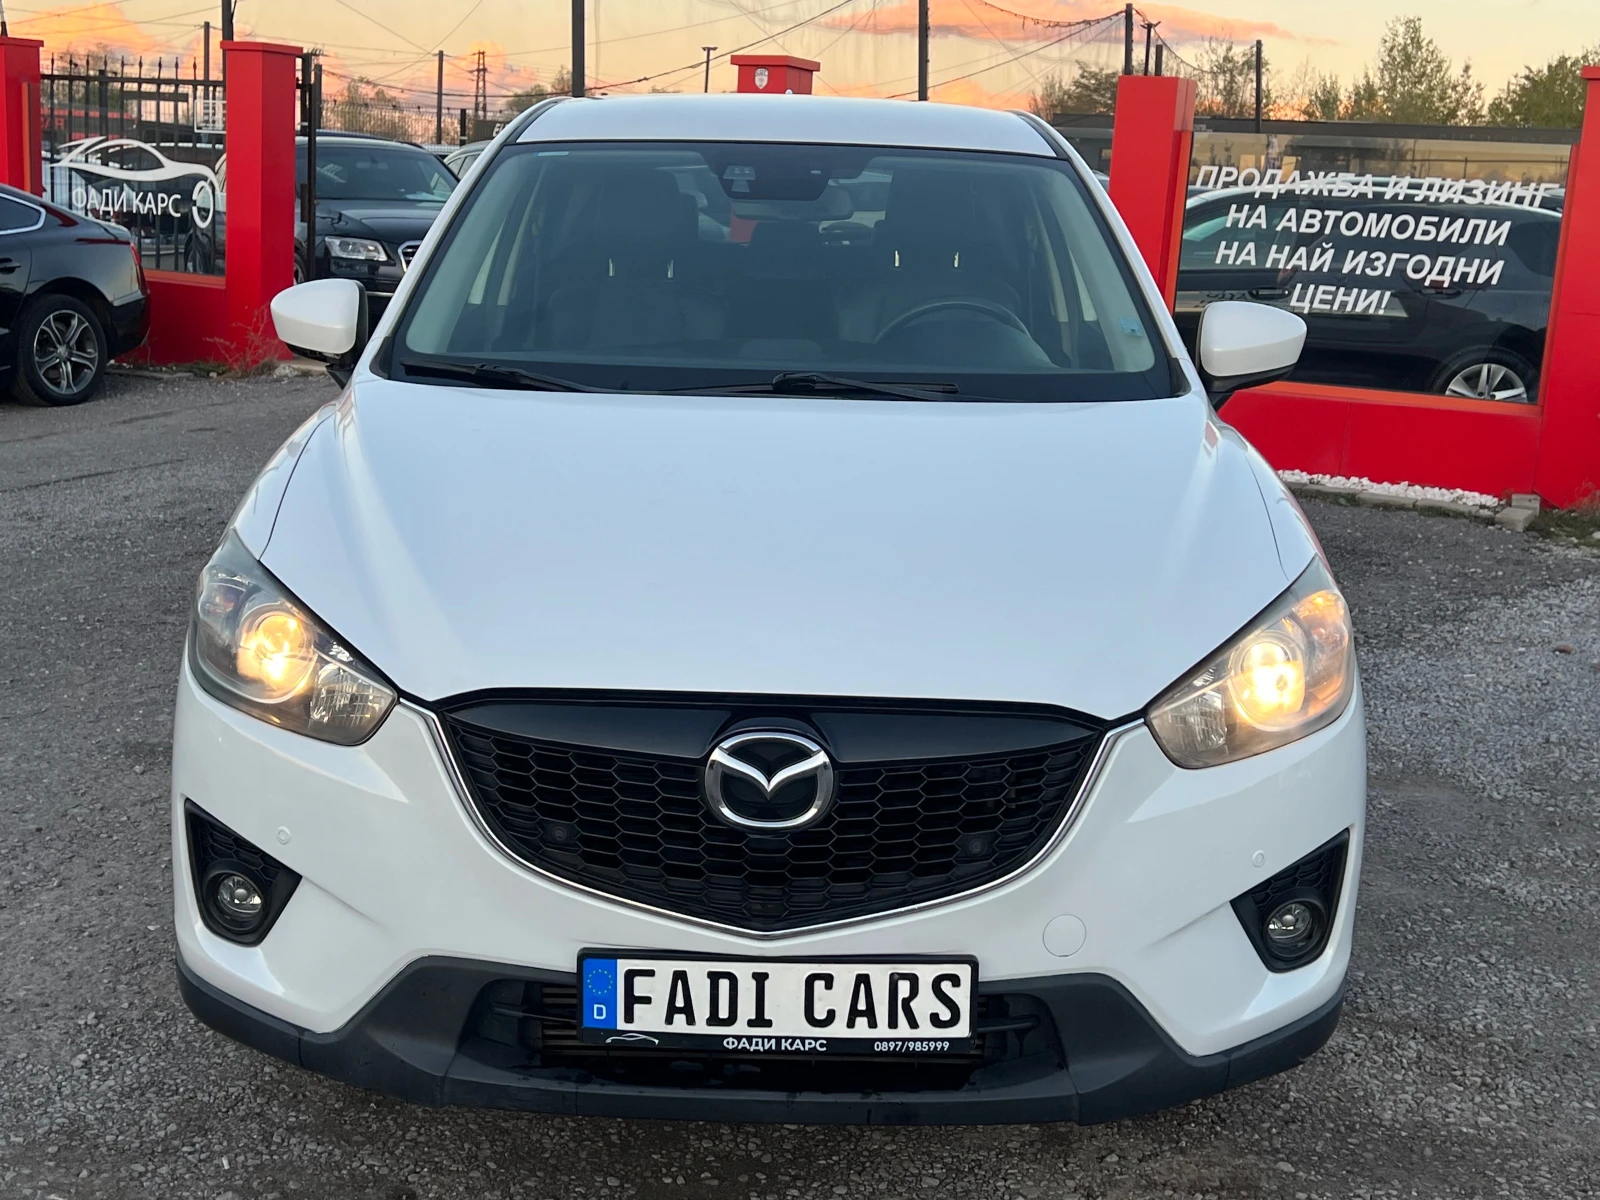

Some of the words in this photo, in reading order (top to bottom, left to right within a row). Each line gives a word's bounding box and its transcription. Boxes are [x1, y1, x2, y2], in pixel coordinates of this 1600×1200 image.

[72, 188, 126, 216] ФАДИ
[132, 190, 182, 217] КАРС
[1196, 166, 1373, 200] ПРОДАЖБА
[1384, 175, 1411, 201] И
[1414, 177, 1560, 208] ЛИЗИНГ
[1225, 204, 1267, 230] НА
[1276, 208, 1511, 246] АВТОМОБИЛИ
[1215, 240, 1257, 266] НА
[1265, 242, 1335, 273] НАЙ
[1342, 250, 1505, 288] ИЗГОДНИ
[1289, 283, 1391, 314] ЦЕНИ!
[593, 1004, 607, 1020] D
[623, 968, 773, 1028] FADI
[804, 972, 961, 1029] CARS
[723, 1037, 776, 1052] ФАДИ
[781, 1038, 828, 1052] КАРС
[874, 1041, 950, 1053] 0897/985999
